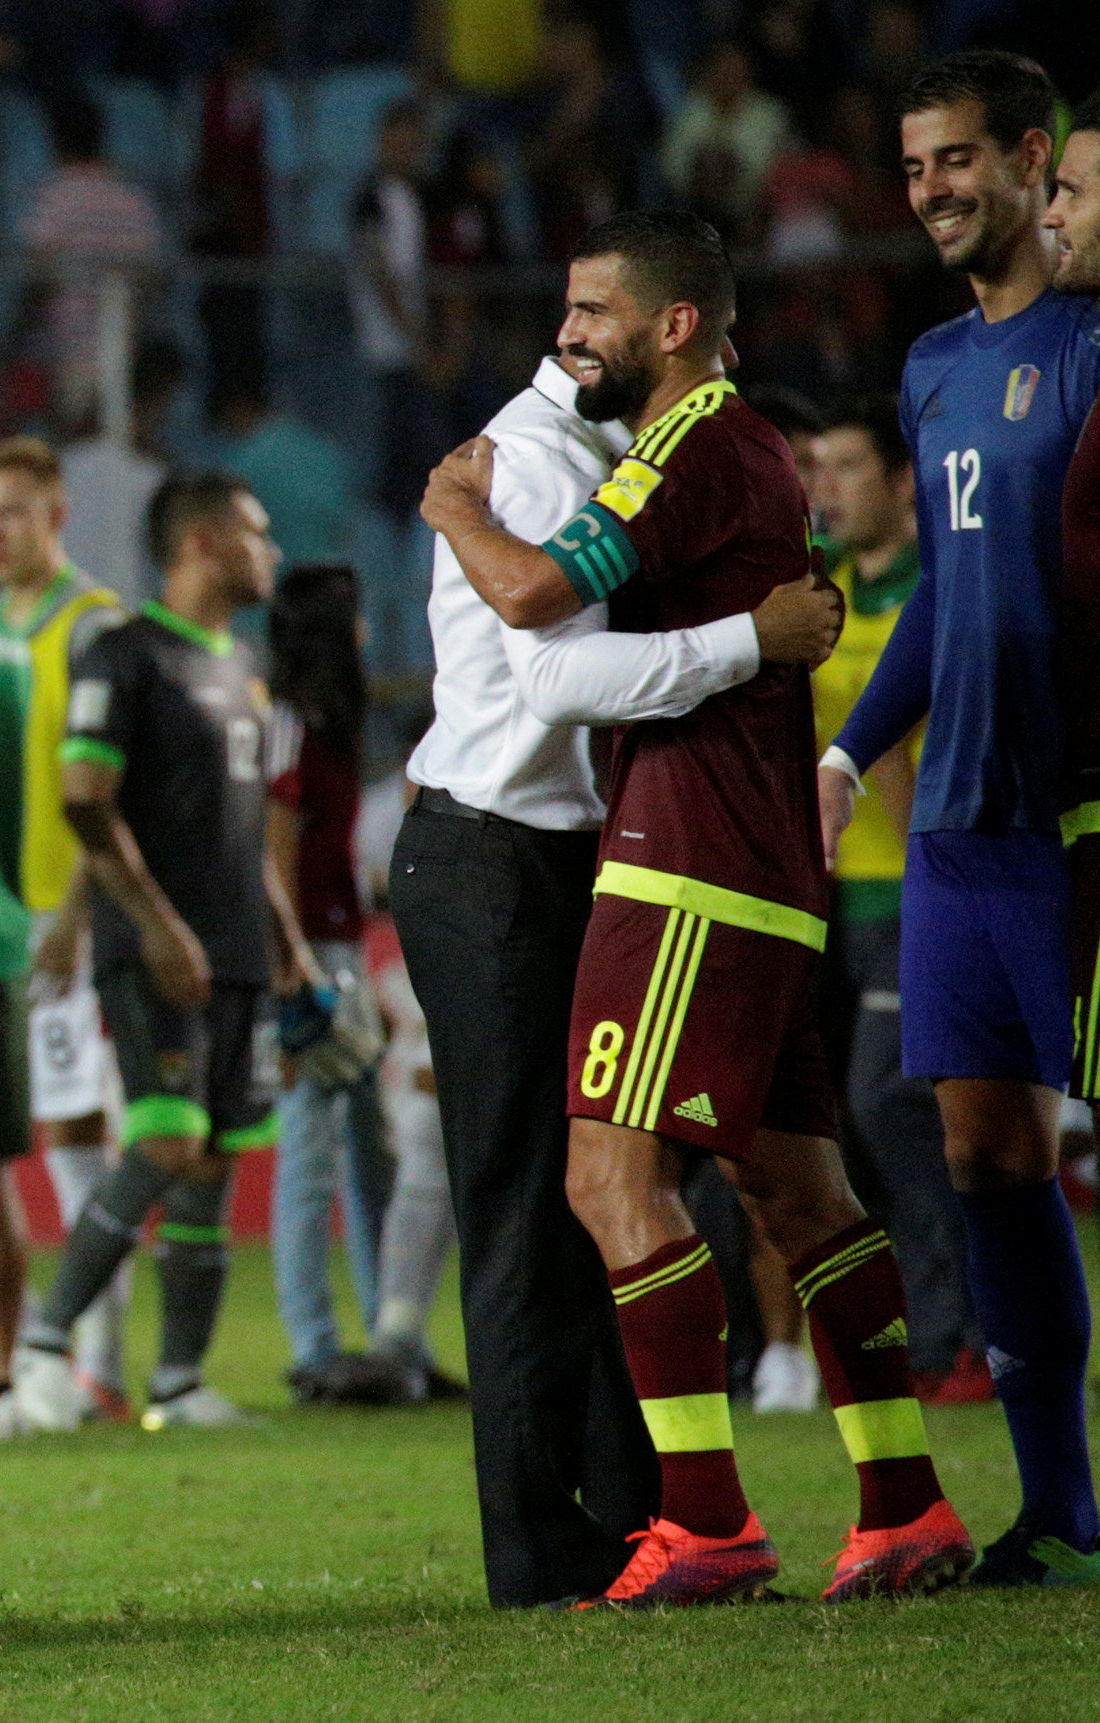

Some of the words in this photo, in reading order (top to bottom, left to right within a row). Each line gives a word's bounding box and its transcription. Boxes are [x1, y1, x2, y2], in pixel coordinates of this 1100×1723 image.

[943, 448, 983, 531] 12
[552, 512, 602, 551] C
[581, 1020, 625, 1099] 8
[673, 1106, 718, 1128] adidas
